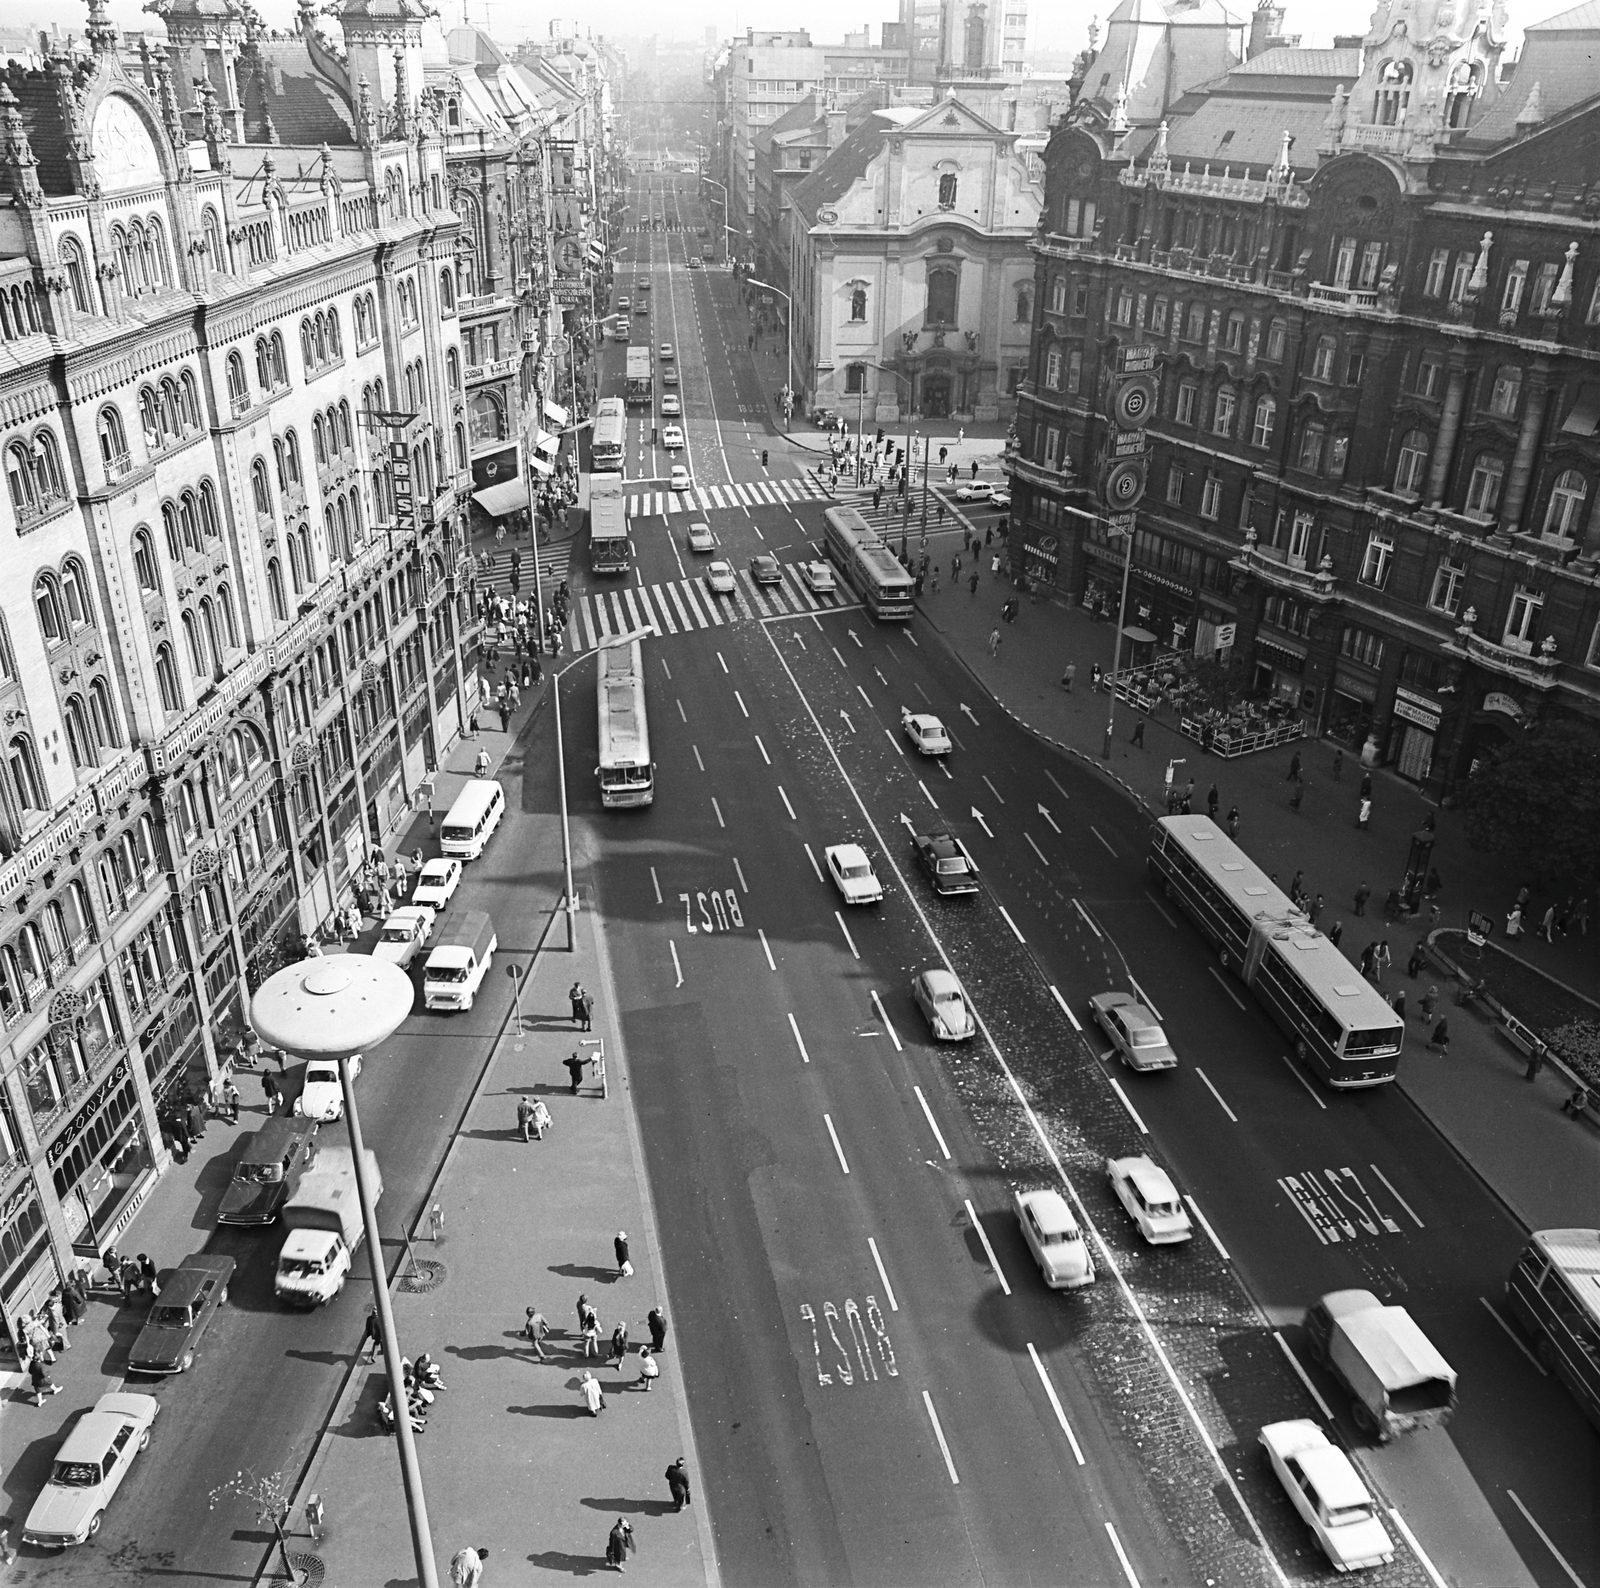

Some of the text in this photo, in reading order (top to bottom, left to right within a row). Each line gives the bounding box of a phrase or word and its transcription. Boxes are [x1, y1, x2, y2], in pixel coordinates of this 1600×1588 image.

[395, 444, 414, 529] IBUSZ
[1412, 707, 1439, 724] MAGYAR
[679, 889, 744, 933] BUSZ
[1285, 1167, 1400, 1242] BUSZ
[800, 1296, 899, 1386] BUSZ
